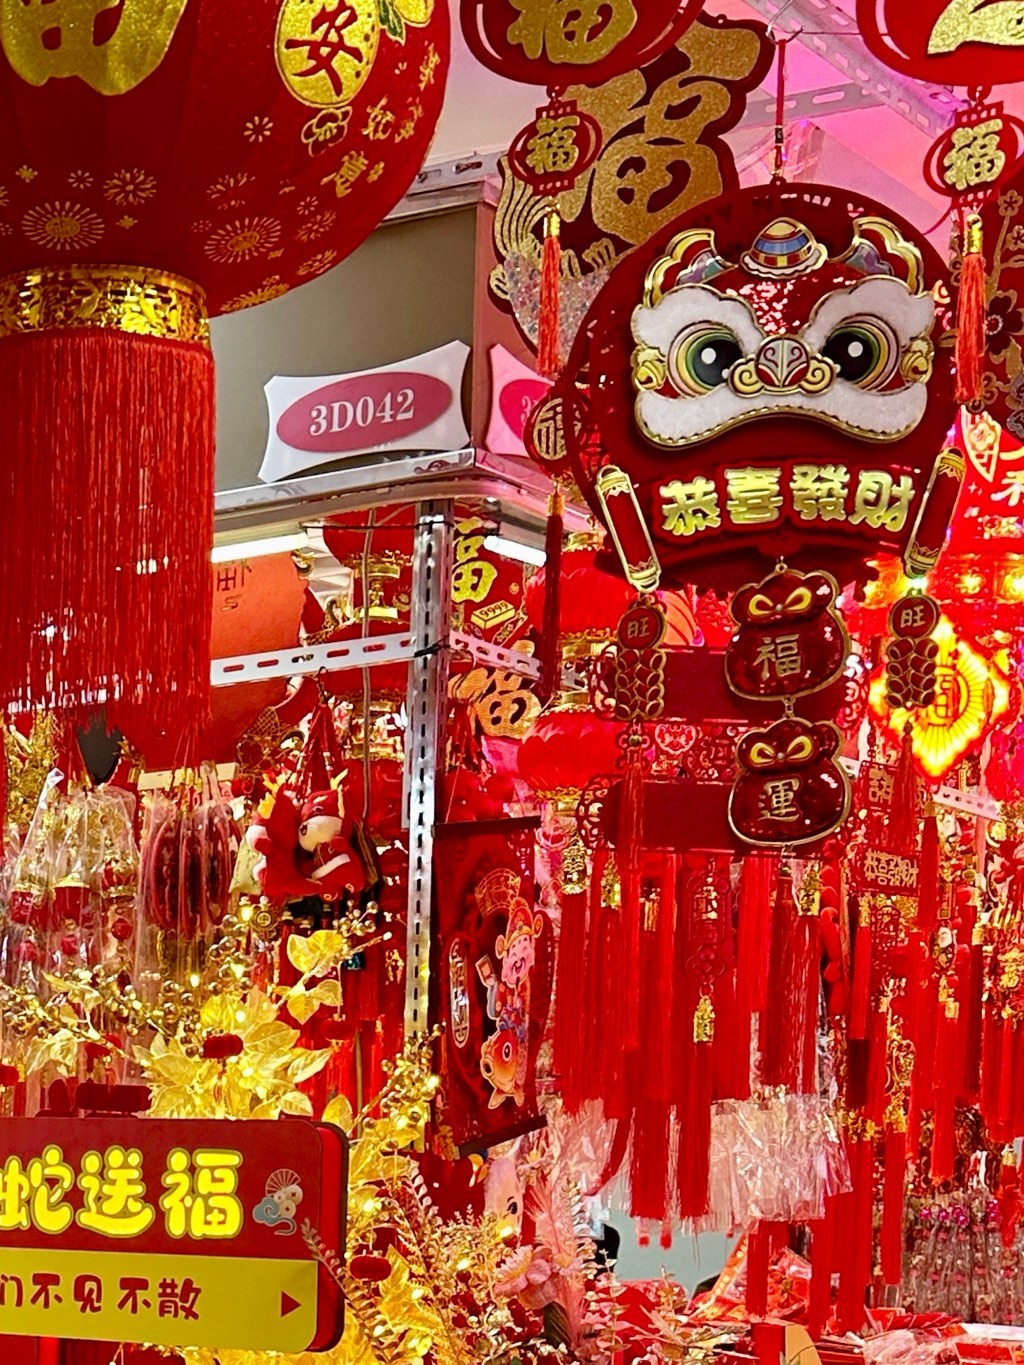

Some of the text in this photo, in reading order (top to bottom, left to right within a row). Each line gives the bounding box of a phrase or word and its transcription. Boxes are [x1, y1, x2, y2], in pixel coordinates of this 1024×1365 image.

[526, 115, 580, 173] 福
[943, 118, 1007, 191] 福
[309, 388, 416, 437] 3D042
[661, 463, 916, 537] 恭喜發財
[627, 614, 651, 640] 旺
[900, 604, 926, 629] 旺
[753, 634, 803, 678] 福
[758, 778, 800, 822] 運
